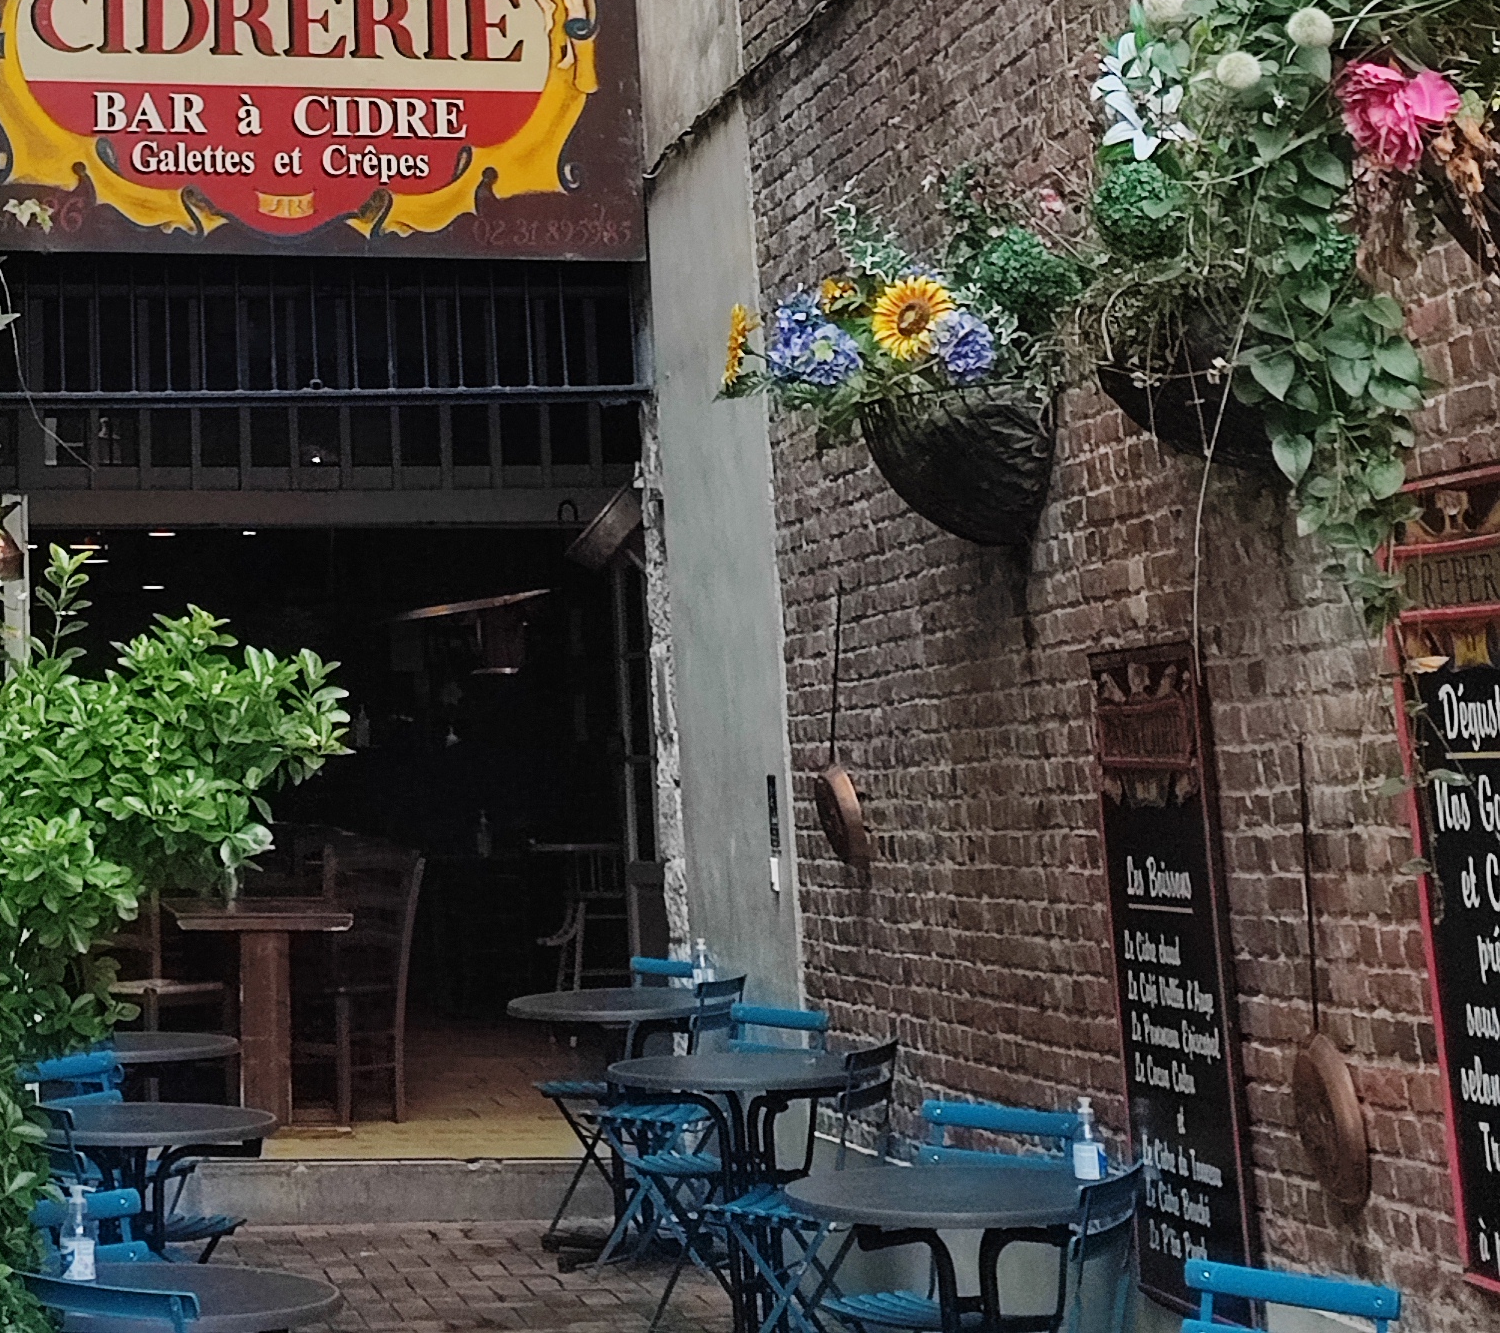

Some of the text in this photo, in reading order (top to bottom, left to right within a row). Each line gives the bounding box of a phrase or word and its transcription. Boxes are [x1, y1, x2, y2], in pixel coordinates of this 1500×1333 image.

[93, 91, 468, 139] BAR à CIDRE
[131, 141, 430, 185] Galettes et Crêpes
[1435, 778, 1471, 832] Nos
[1461, 856, 1480, 909] et
